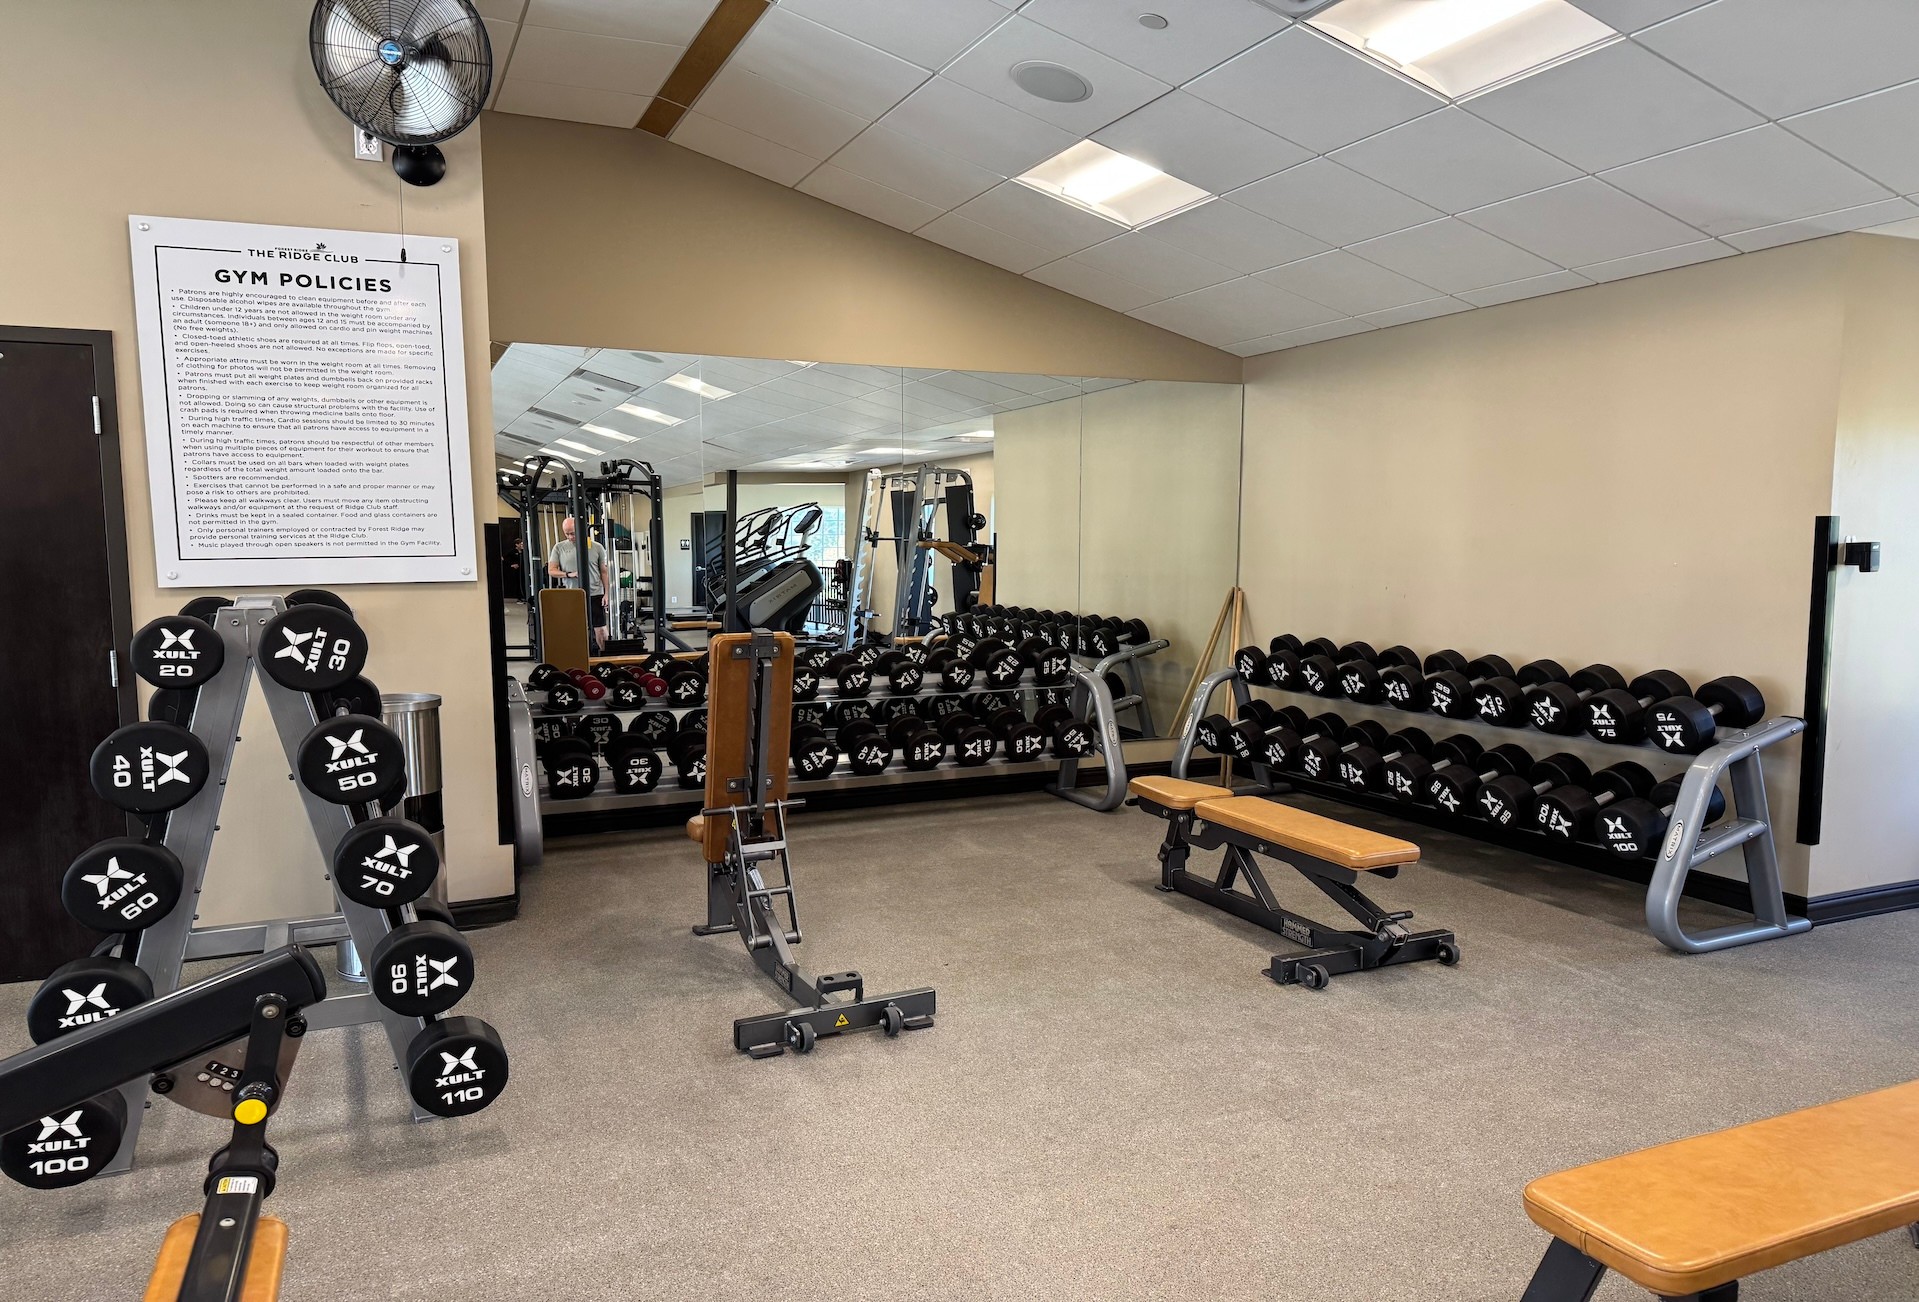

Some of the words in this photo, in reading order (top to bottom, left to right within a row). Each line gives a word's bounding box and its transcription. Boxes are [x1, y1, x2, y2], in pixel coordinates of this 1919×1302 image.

[247, 249, 274, 258] THE
[279, 251, 321, 261] RIDGE
[324, 254, 359, 264] CLUB
[214, 269, 268, 286] GYM
[280, 273, 392, 293] POLICIES
[227, 312, 265, 320] Individuals
[266, 314, 297, 322] between
[376, 320, 420, 329] accompanied
[257, 373, 283, 381] weight
[385, 377, 414, 385] provided
[186, 392, 220, 400] Dropping
[231, 394, 267, 402] slamming
[385, 398, 421, 406] equipment
[153, 650, 201, 660] XULT
[305, 627, 328, 673] XULT
[328, 638, 351, 672] 30
[159, 664, 194, 677] 20
[1043, 661, 1050, 674] 25
[1308, 672, 1319, 686] XULT
[1431, 690, 1452, 704] XULT
[1485, 694, 1498, 717] XULT
[1495, 696, 1506, 713] 70
[1530, 709, 1545, 726] 70
[1533, 700, 1555, 723] XULT
[1655, 712, 1676, 722] 75
[1064, 729, 1077, 742] 50
[1598, 728, 1617, 737] 75
[1656, 724, 1683, 732] XULT
[984, 739, 991, 753] 45
[1016, 739, 1023, 753] 50
[1068, 731, 1084, 748] XULT
[1235, 741, 1246, 751] XULT
[809, 751, 823, 768] XULT
[858, 746, 868, 760] 40
[866, 746, 879, 765] XULT
[914, 746, 921, 760] 45
[140, 745, 155, 792] XULT
[324, 752, 379, 773] XULT
[630, 758, 649, 766] 30
[802, 758, 813, 772] 40
[112, 754, 132, 788] 40
[583, 767, 591, 783] 30
[337, 771, 377, 791] 50
[1437, 786, 1450, 804] XULT
[1490, 799, 1504, 818] XULT
[1538, 803, 1550, 824] 100
[1549, 808, 1560, 831] XULT
[1607, 832, 1633, 840] XULT
[1613, 842, 1638, 852] 100
[360, 856, 413, 879] XULT
[97, 872, 148, 911] XULT
[360, 875, 395, 896] 70
[120, 892, 159, 921] 60
[1284, 918, 1311, 936] HAMMER
[1281, 927, 1312, 946] STRENGTH
[391, 963, 408, 994] 90
[415, 954, 428, 997] XULT
[58, 1008, 120, 1029] XULT
[210, 1063, 218, 1071] 1
[220, 1067, 227, 1075] 2
[230, 1070, 239, 1078] 3
[435, 1069, 486, 1087] XULT
[441, 1087, 484, 1105] 110
[27, 1137, 91, 1154] XULT
[28, 1156, 89, 1176] 100
